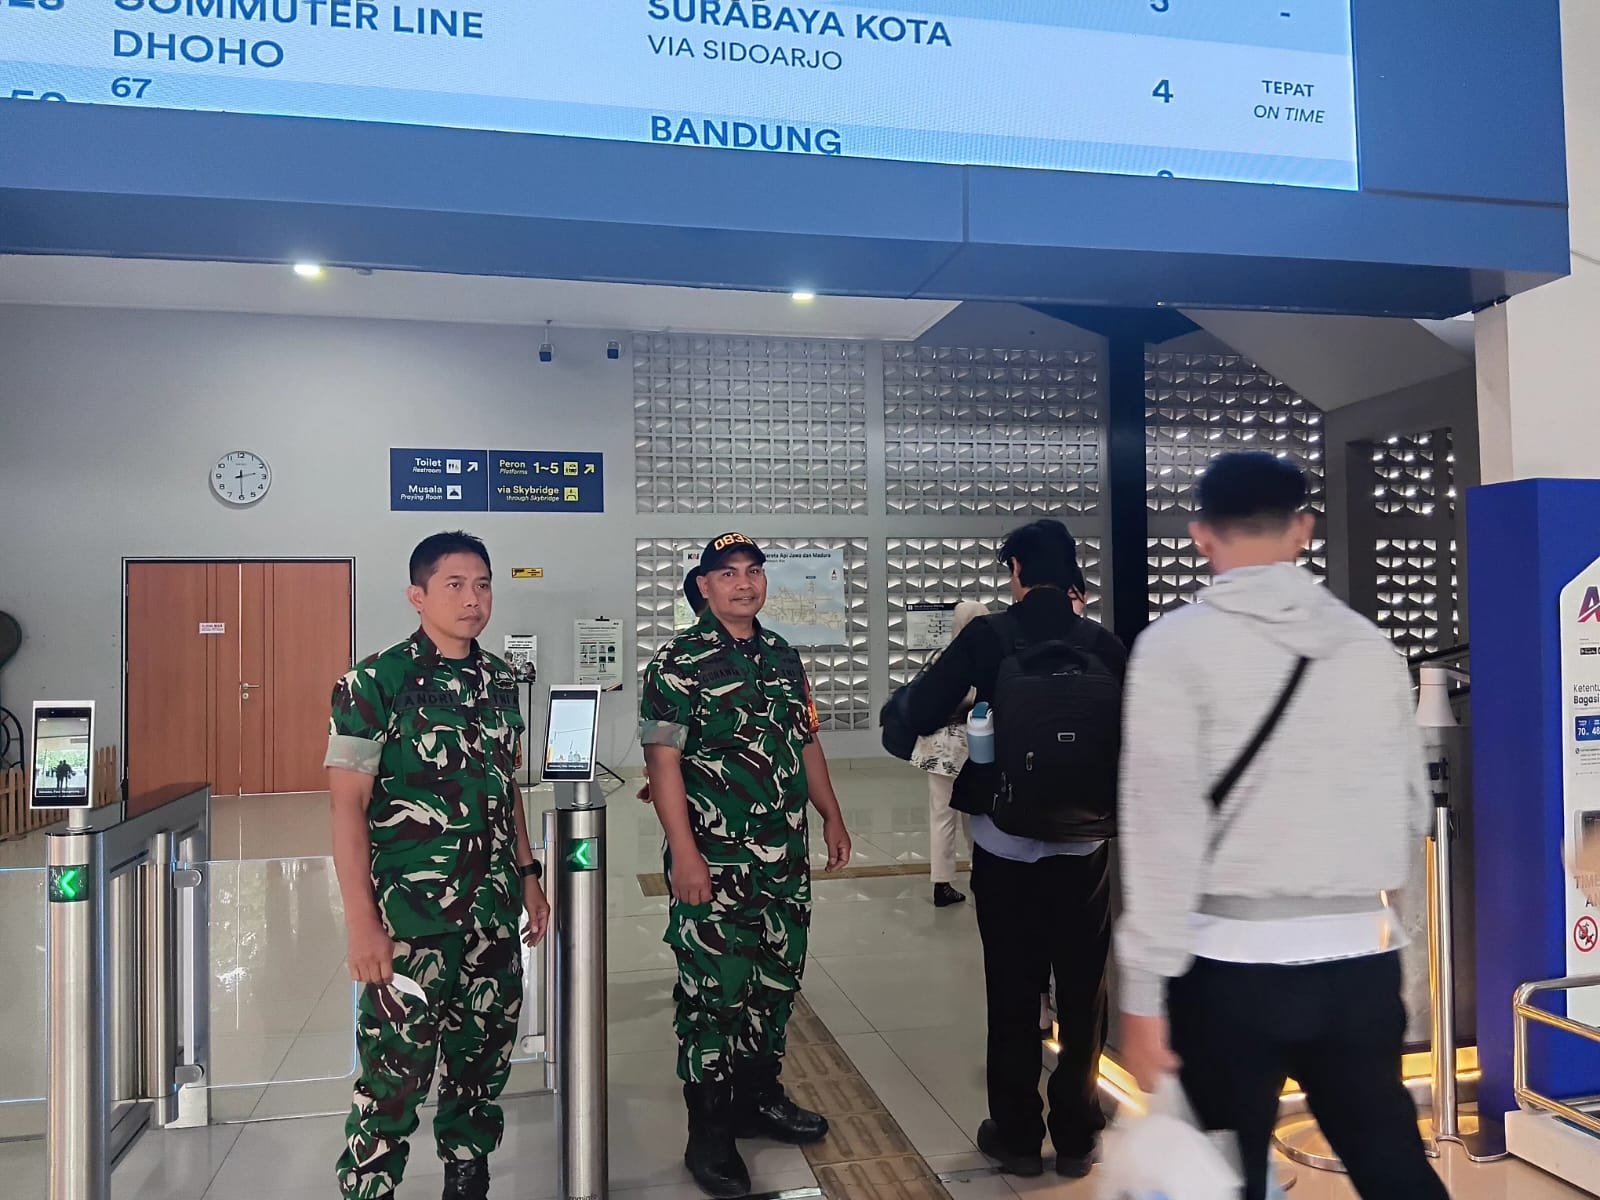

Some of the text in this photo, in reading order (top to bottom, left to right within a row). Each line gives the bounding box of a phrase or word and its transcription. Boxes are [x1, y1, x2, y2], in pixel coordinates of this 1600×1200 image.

[394, 6, 483, 39] LINE
[647, 0, 952, 46] SURABAYA KOTA
[113, 29, 284, 68] DHOHO
[647, 34, 843, 71] VIA SIDOARJO
[111, 76, 152, 99] 67
[1152, 79, 1174, 104] 4
[1261, 79, 1315, 97] TEPAT
[1253, 104, 1326, 124] ON TIME
[651, 115, 842, 155] BANDUNG
[415, 457, 442, 467] Toilet
[499, 459, 526, 468] Peron
[400, 493, 424, 501] Praying
[408, 484, 443, 494] Musala
[497, 484, 560, 496] via Skybridge
